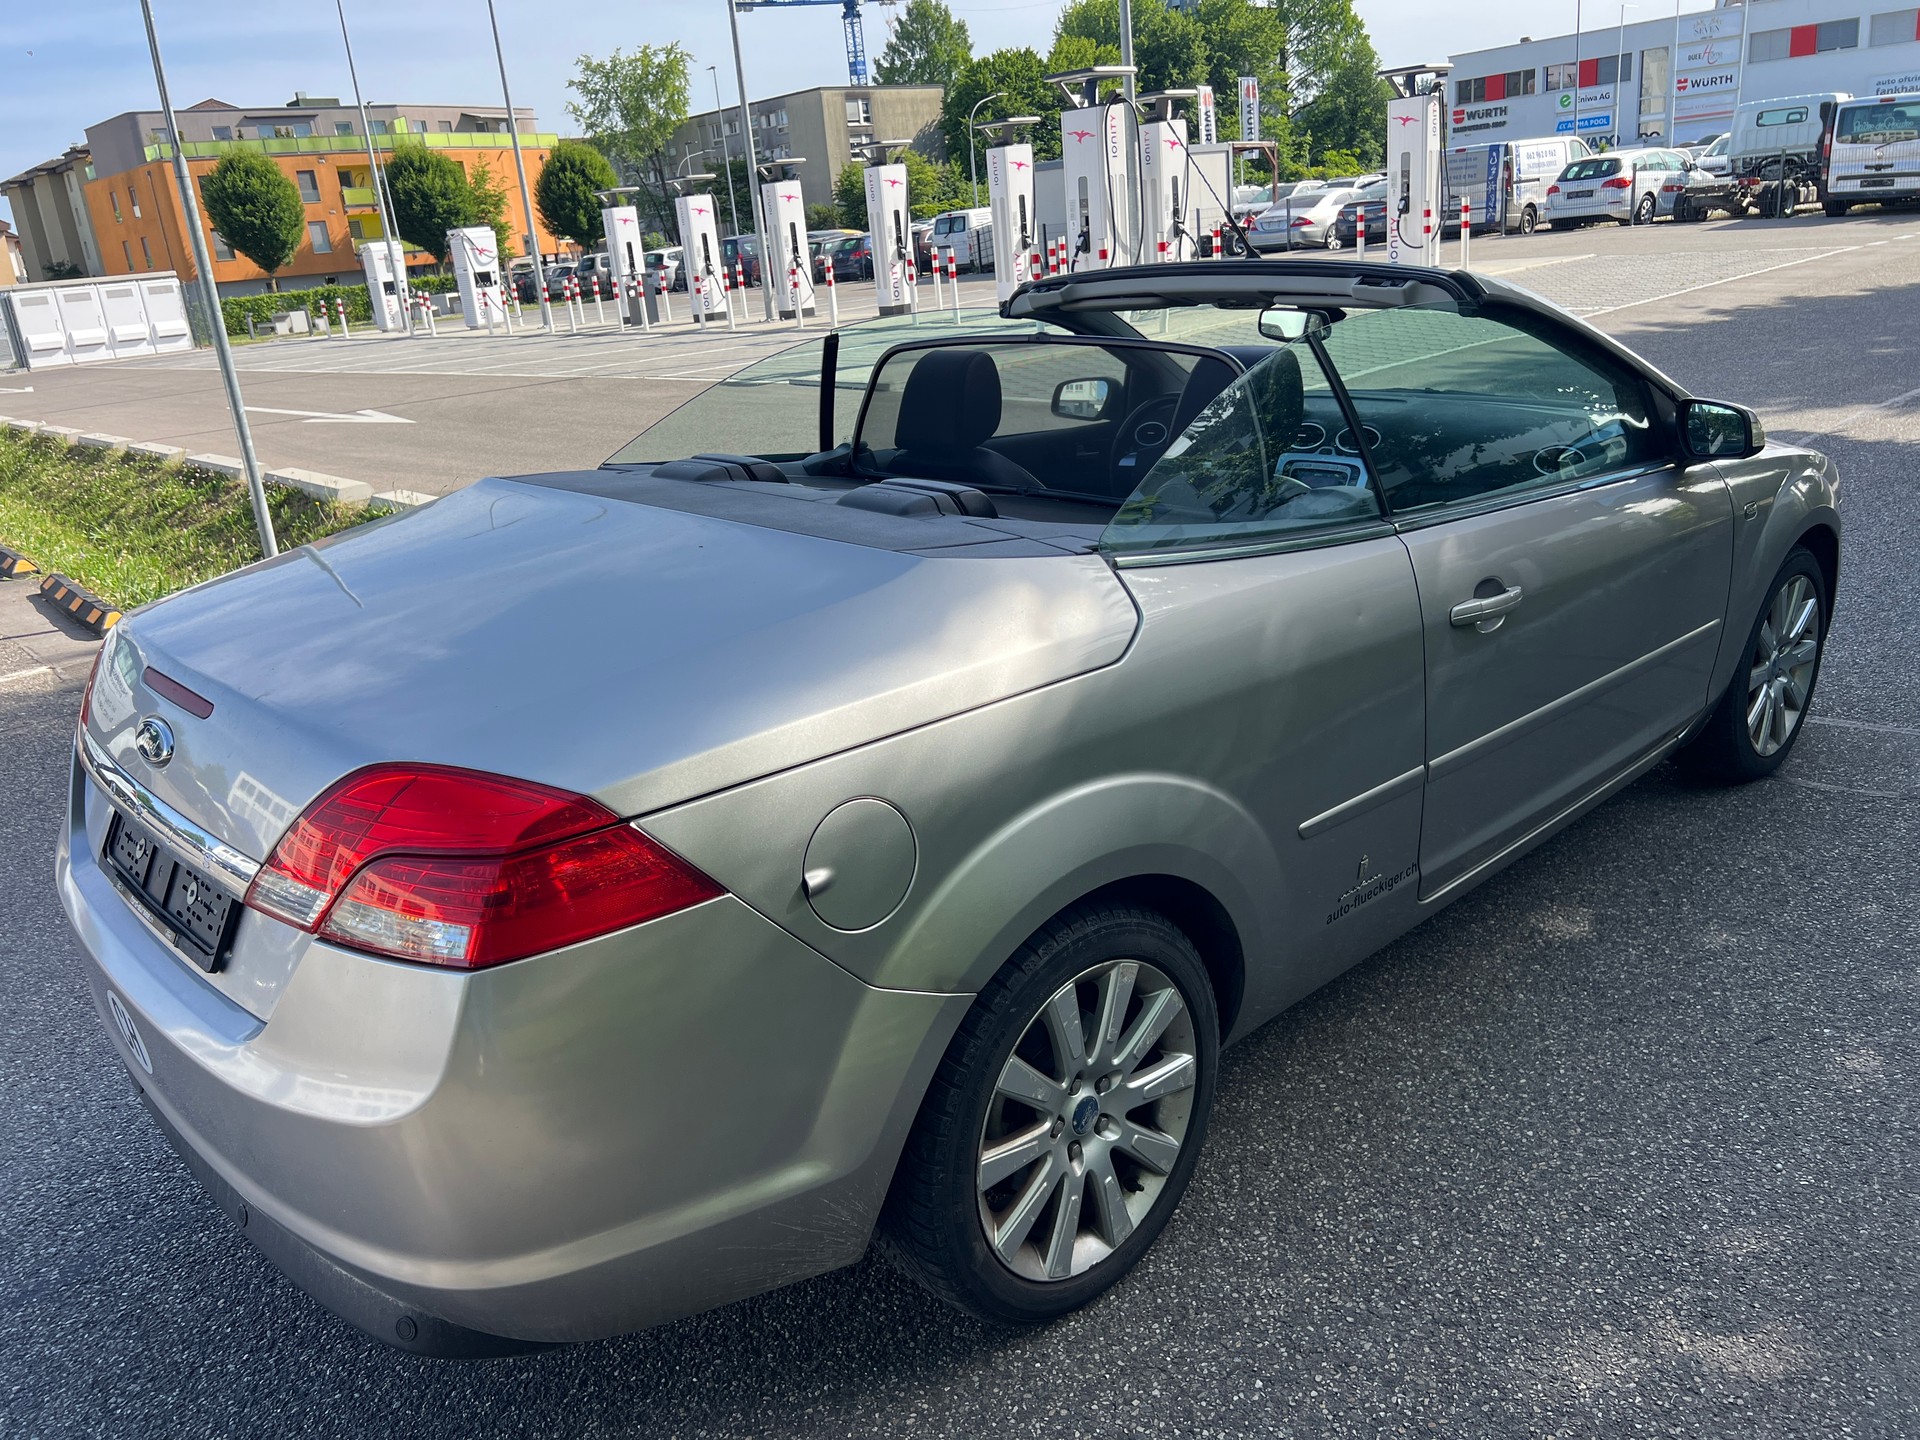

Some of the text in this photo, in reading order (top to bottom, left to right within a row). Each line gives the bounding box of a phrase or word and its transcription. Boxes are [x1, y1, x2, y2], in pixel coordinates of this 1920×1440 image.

[1598, 92, 1611, 101] AG
[1690, 74, 1734, 88] WÜRTH
[1875, 78, 1896, 86] auto
[1204, 110, 1212, 144] WÜR
[1466, 105, 1508, 120] WÜRTH
[1567, 118, 1608, 129] ALHA POOL
[1109, 114, 1118, 158] IONITY
[1143, 130, 1151, 165] IONITY
[890, 262, 900, 302] IONITY
[1326, 862, 1417, 925] auto-flueckiger.ch
[111, 997, 149, 1067] CH
